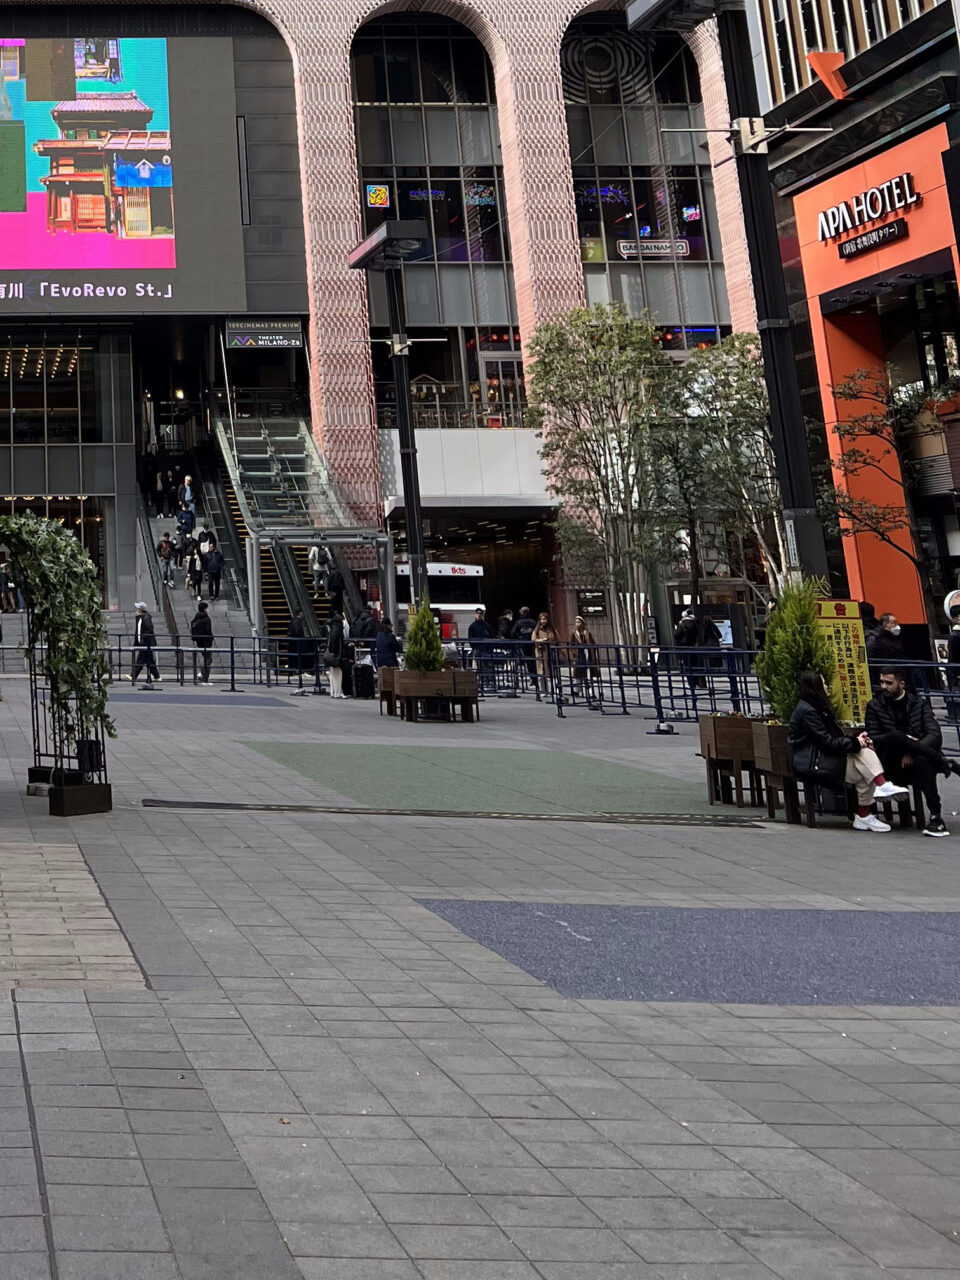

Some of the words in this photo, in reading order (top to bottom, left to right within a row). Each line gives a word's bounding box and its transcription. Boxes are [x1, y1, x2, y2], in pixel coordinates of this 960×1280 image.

[818, 202, 853, 242] APA
[852, 173, 917, 226] HOTEL
[40, 282, 127, 298] 「EvoRevo
[135, 283, 172, 298] St.」
[451, 566, 466, 574] tkts
